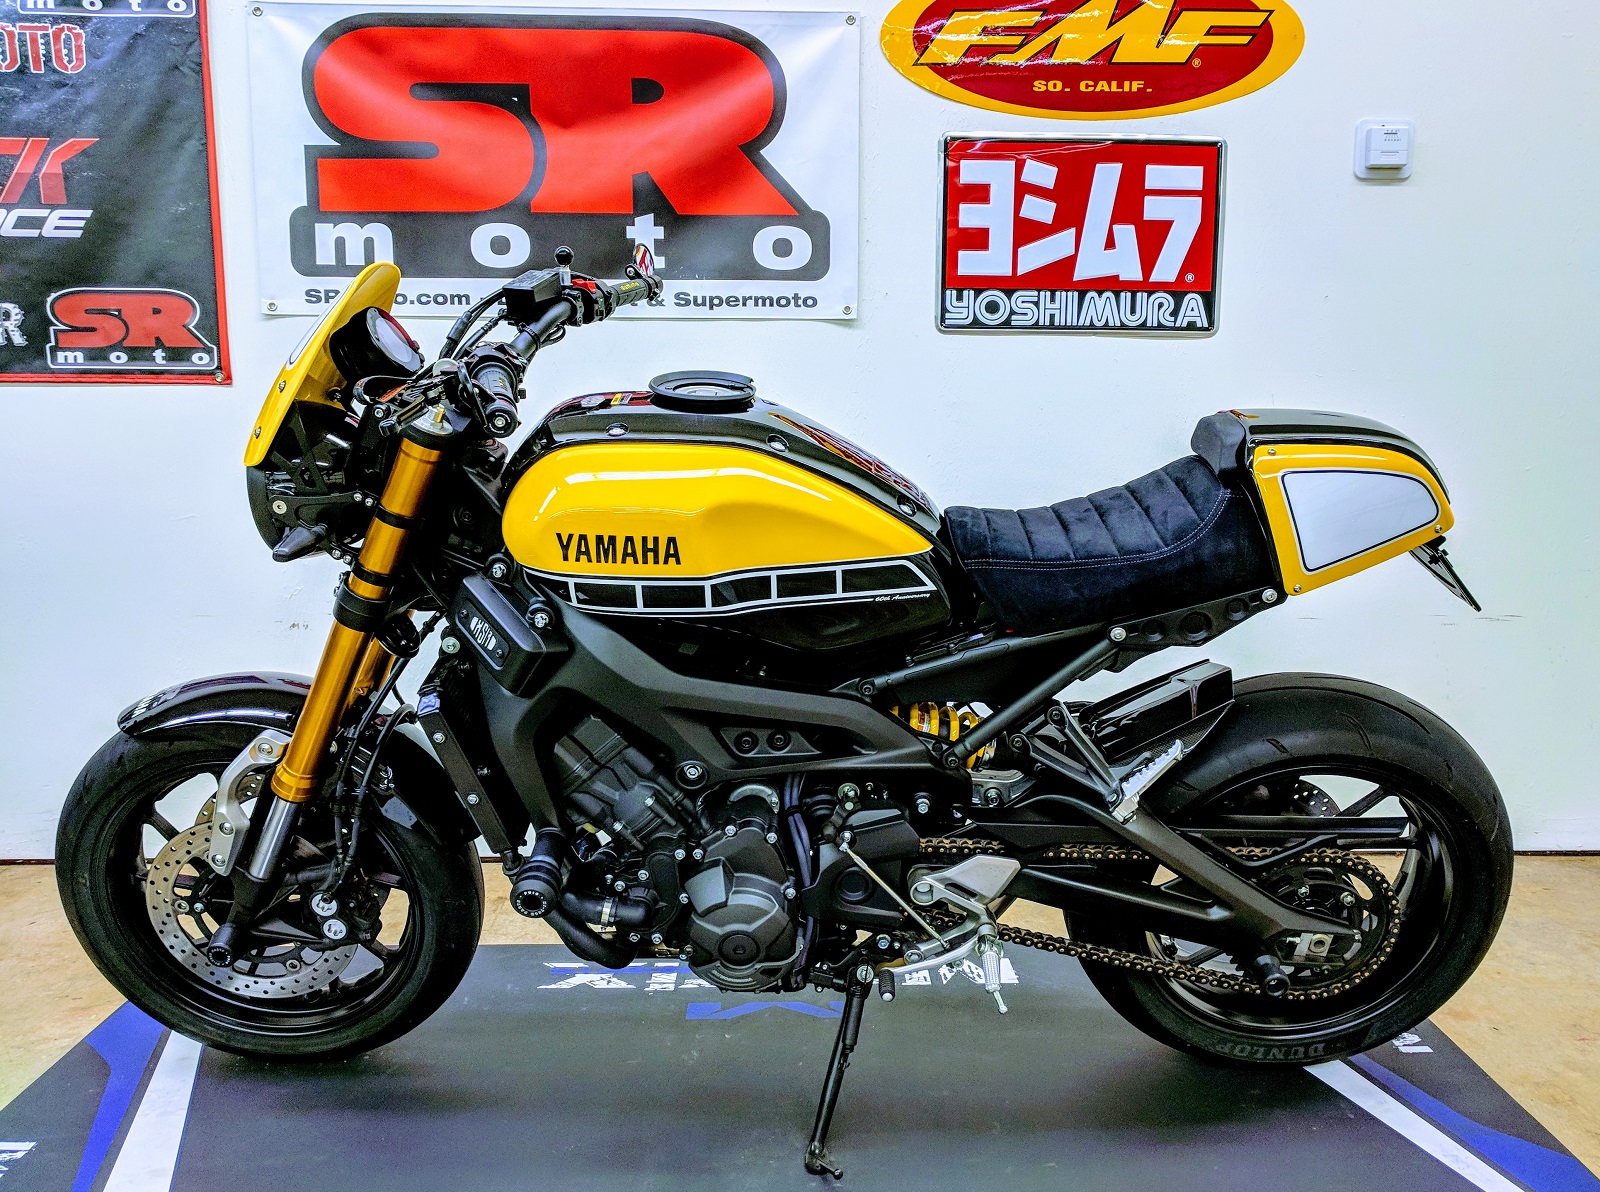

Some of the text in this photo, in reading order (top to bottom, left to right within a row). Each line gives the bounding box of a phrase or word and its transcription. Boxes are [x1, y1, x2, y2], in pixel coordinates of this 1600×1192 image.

[913, 0, 1275, 66] FMF
[1032, 79, 1153, 93] SO. CALIF.
[312, 25, 800, 217] SR
[957, 156, 1205, 283] ヨシムラ
[313, 212, 814, 271] moto
[52, 292, 205, 348] SR
[673, 291, 819, 310] Supermoto
[944, 288, 1209, 328] YOSHIMURA
[56, 348, 211, 365] moto
[555, 532, 682, 566] YAMAHA
[1214, 1042, 1326, 1060] DUNLOP
